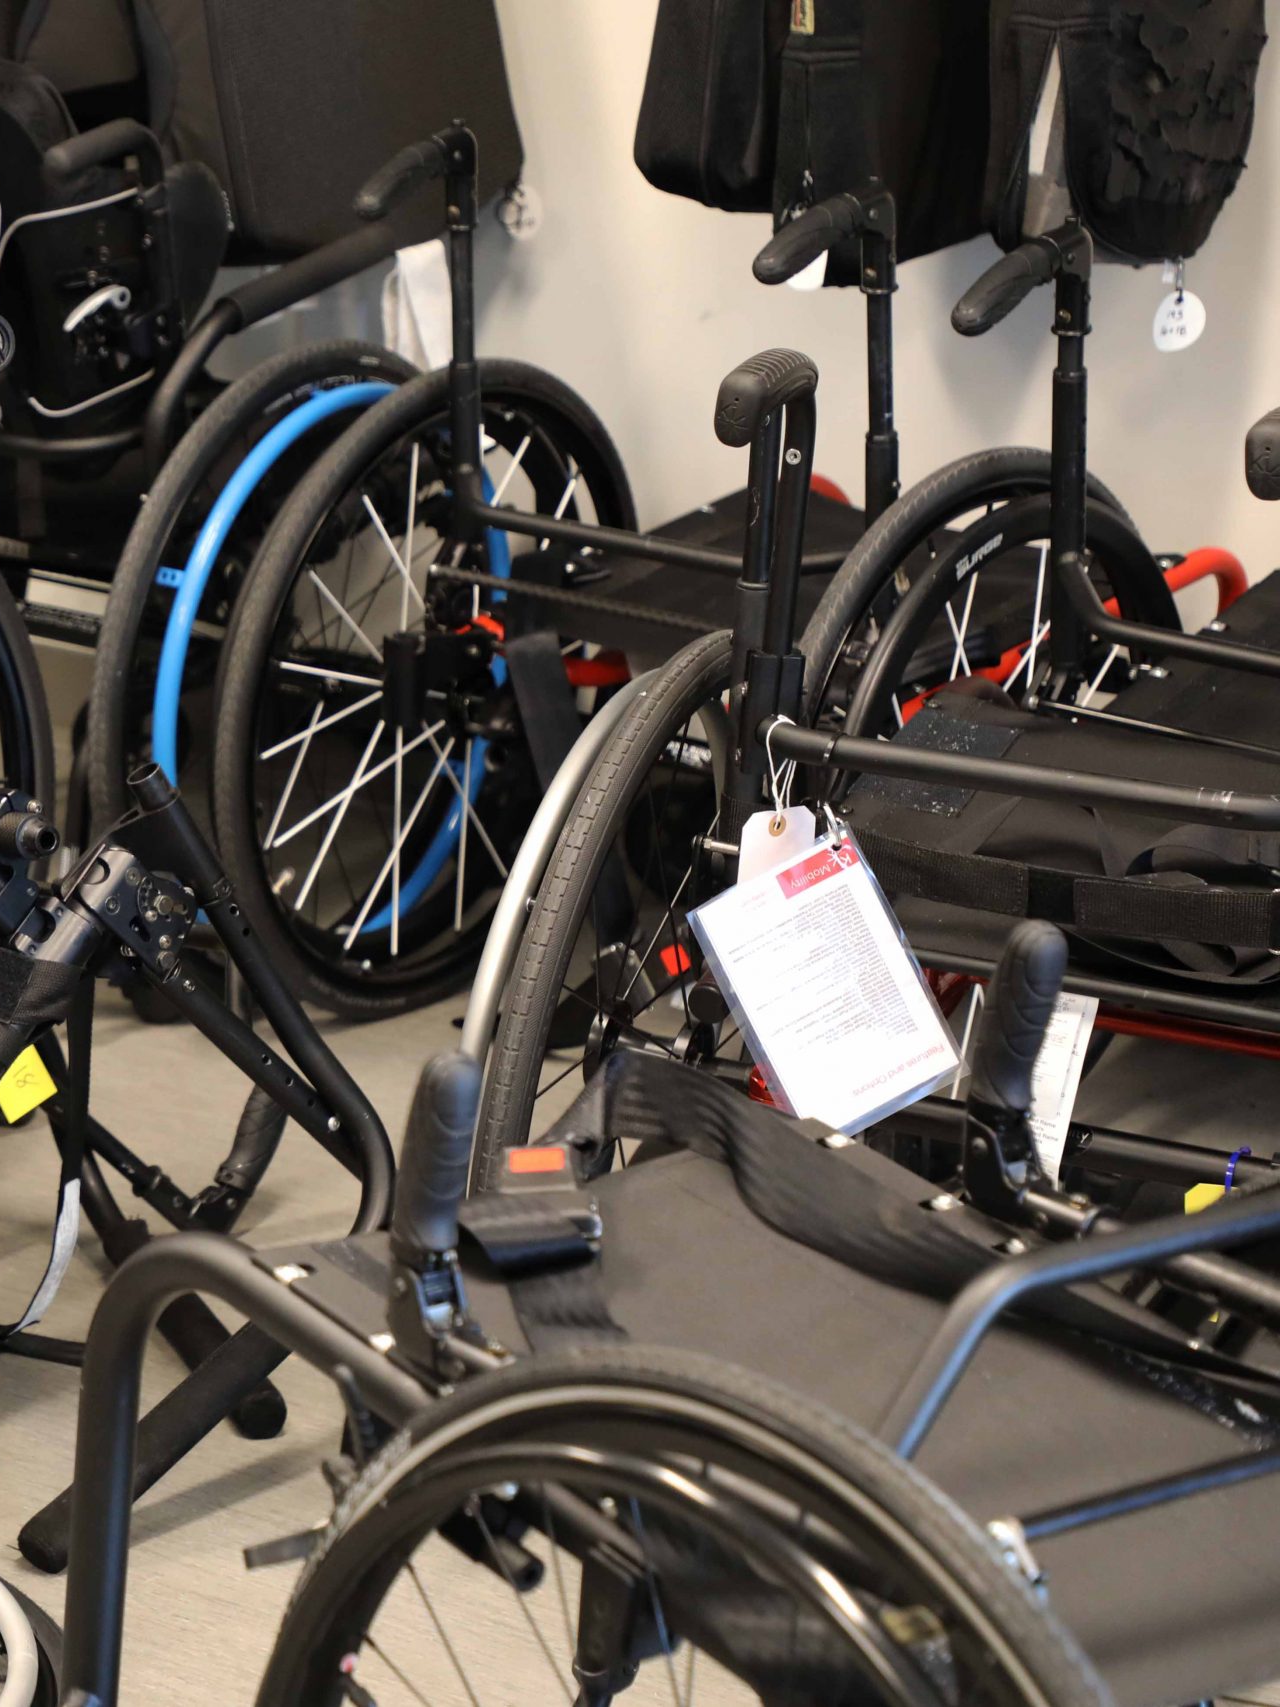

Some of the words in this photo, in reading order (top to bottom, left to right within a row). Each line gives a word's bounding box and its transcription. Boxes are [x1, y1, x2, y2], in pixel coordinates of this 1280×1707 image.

[789, 863, 832, 890] Mobility
[905, 1043, 945, 1069] Features
[887, 1064, 906, 1079] and
[851, 1073, 888, 1098] Options
